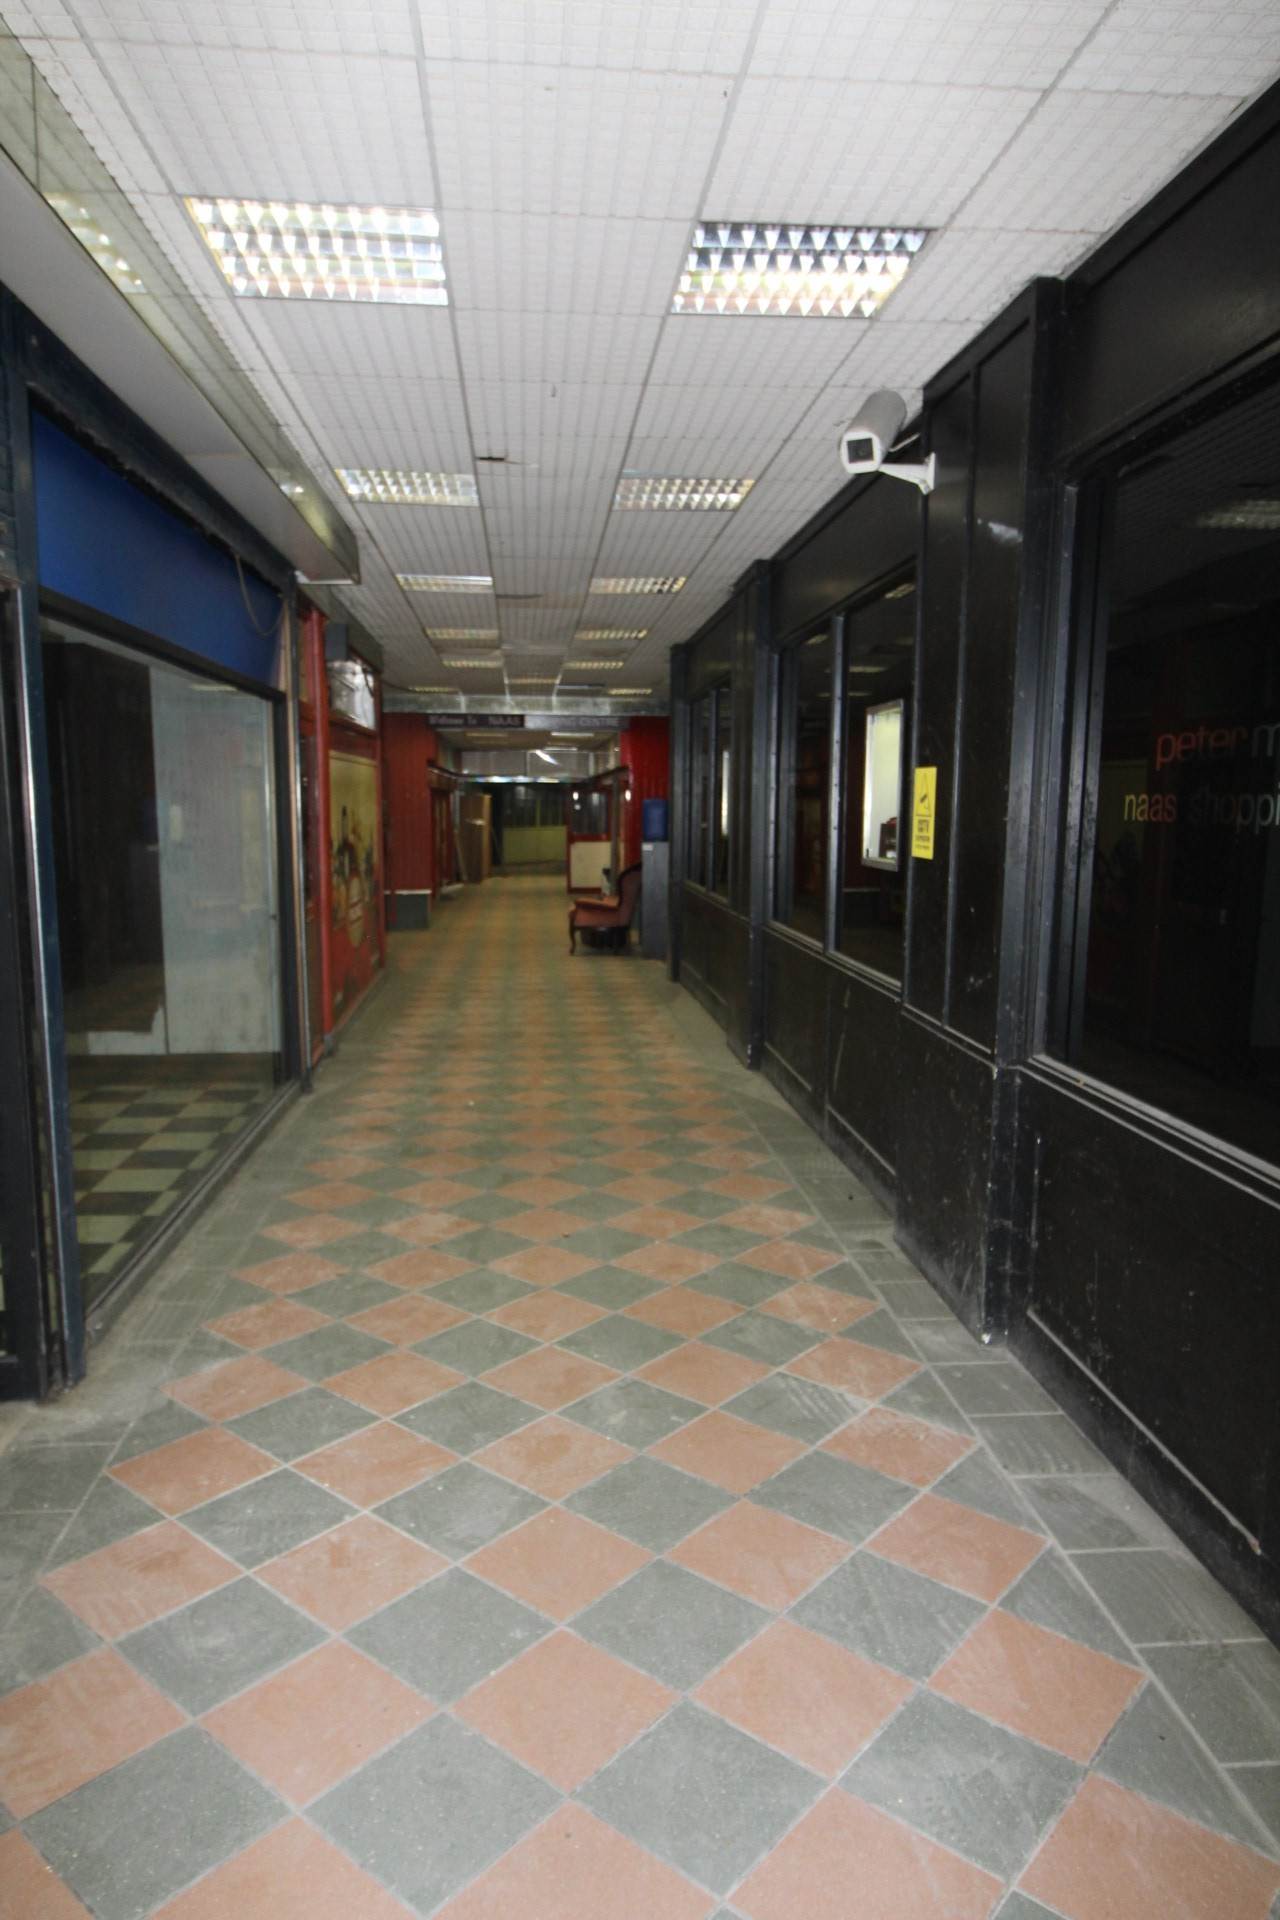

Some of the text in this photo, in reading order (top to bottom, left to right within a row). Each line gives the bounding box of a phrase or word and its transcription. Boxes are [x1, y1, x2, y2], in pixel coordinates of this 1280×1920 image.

[488, 715, 521, 726] NAAS
[1154, 725, 1249, 771] peter
[1123, 793, 1177, 823] naas
